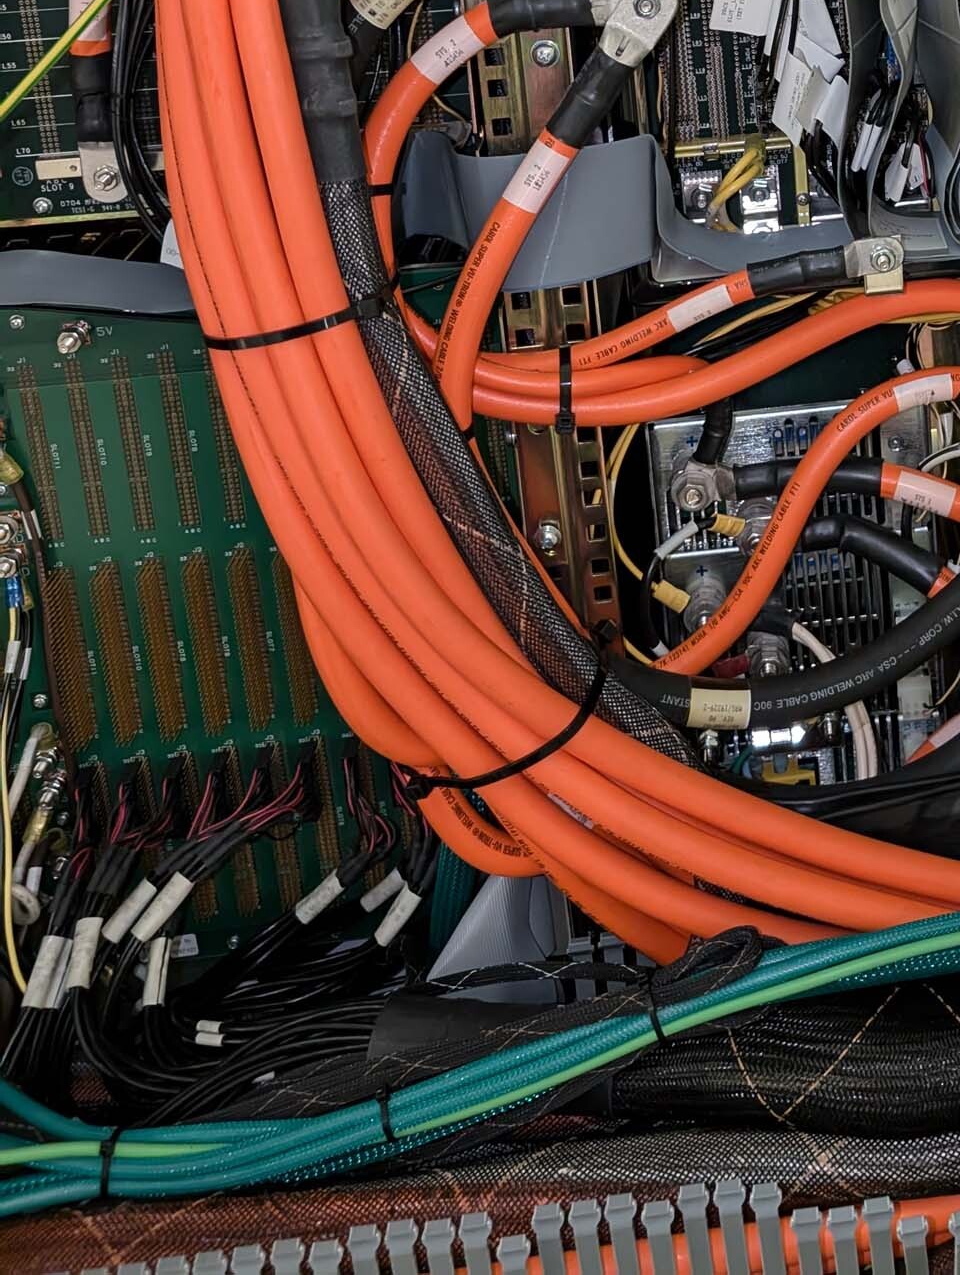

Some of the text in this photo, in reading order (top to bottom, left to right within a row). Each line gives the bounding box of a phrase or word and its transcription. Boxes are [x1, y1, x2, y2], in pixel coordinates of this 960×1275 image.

[41, 184, 64, 192] SLOT
[472, 245, 488, 268] SUPER
[96, 327, 113, 337] 5V
[624, 323, 652, 347] WELDING
[601, 341, 619, 359] CABLE
[836, 394, 881, 433] CAROL SUPER
[759, 523, 779, 557] WELDING
[776, 500, 792, 522] CABLE
[856, 667, 875, 683] ARC
[810, 678, 856, 704] WELDING
[753, 701, 773, 711] 90C
[776, 694, 810, 710] CABLE
